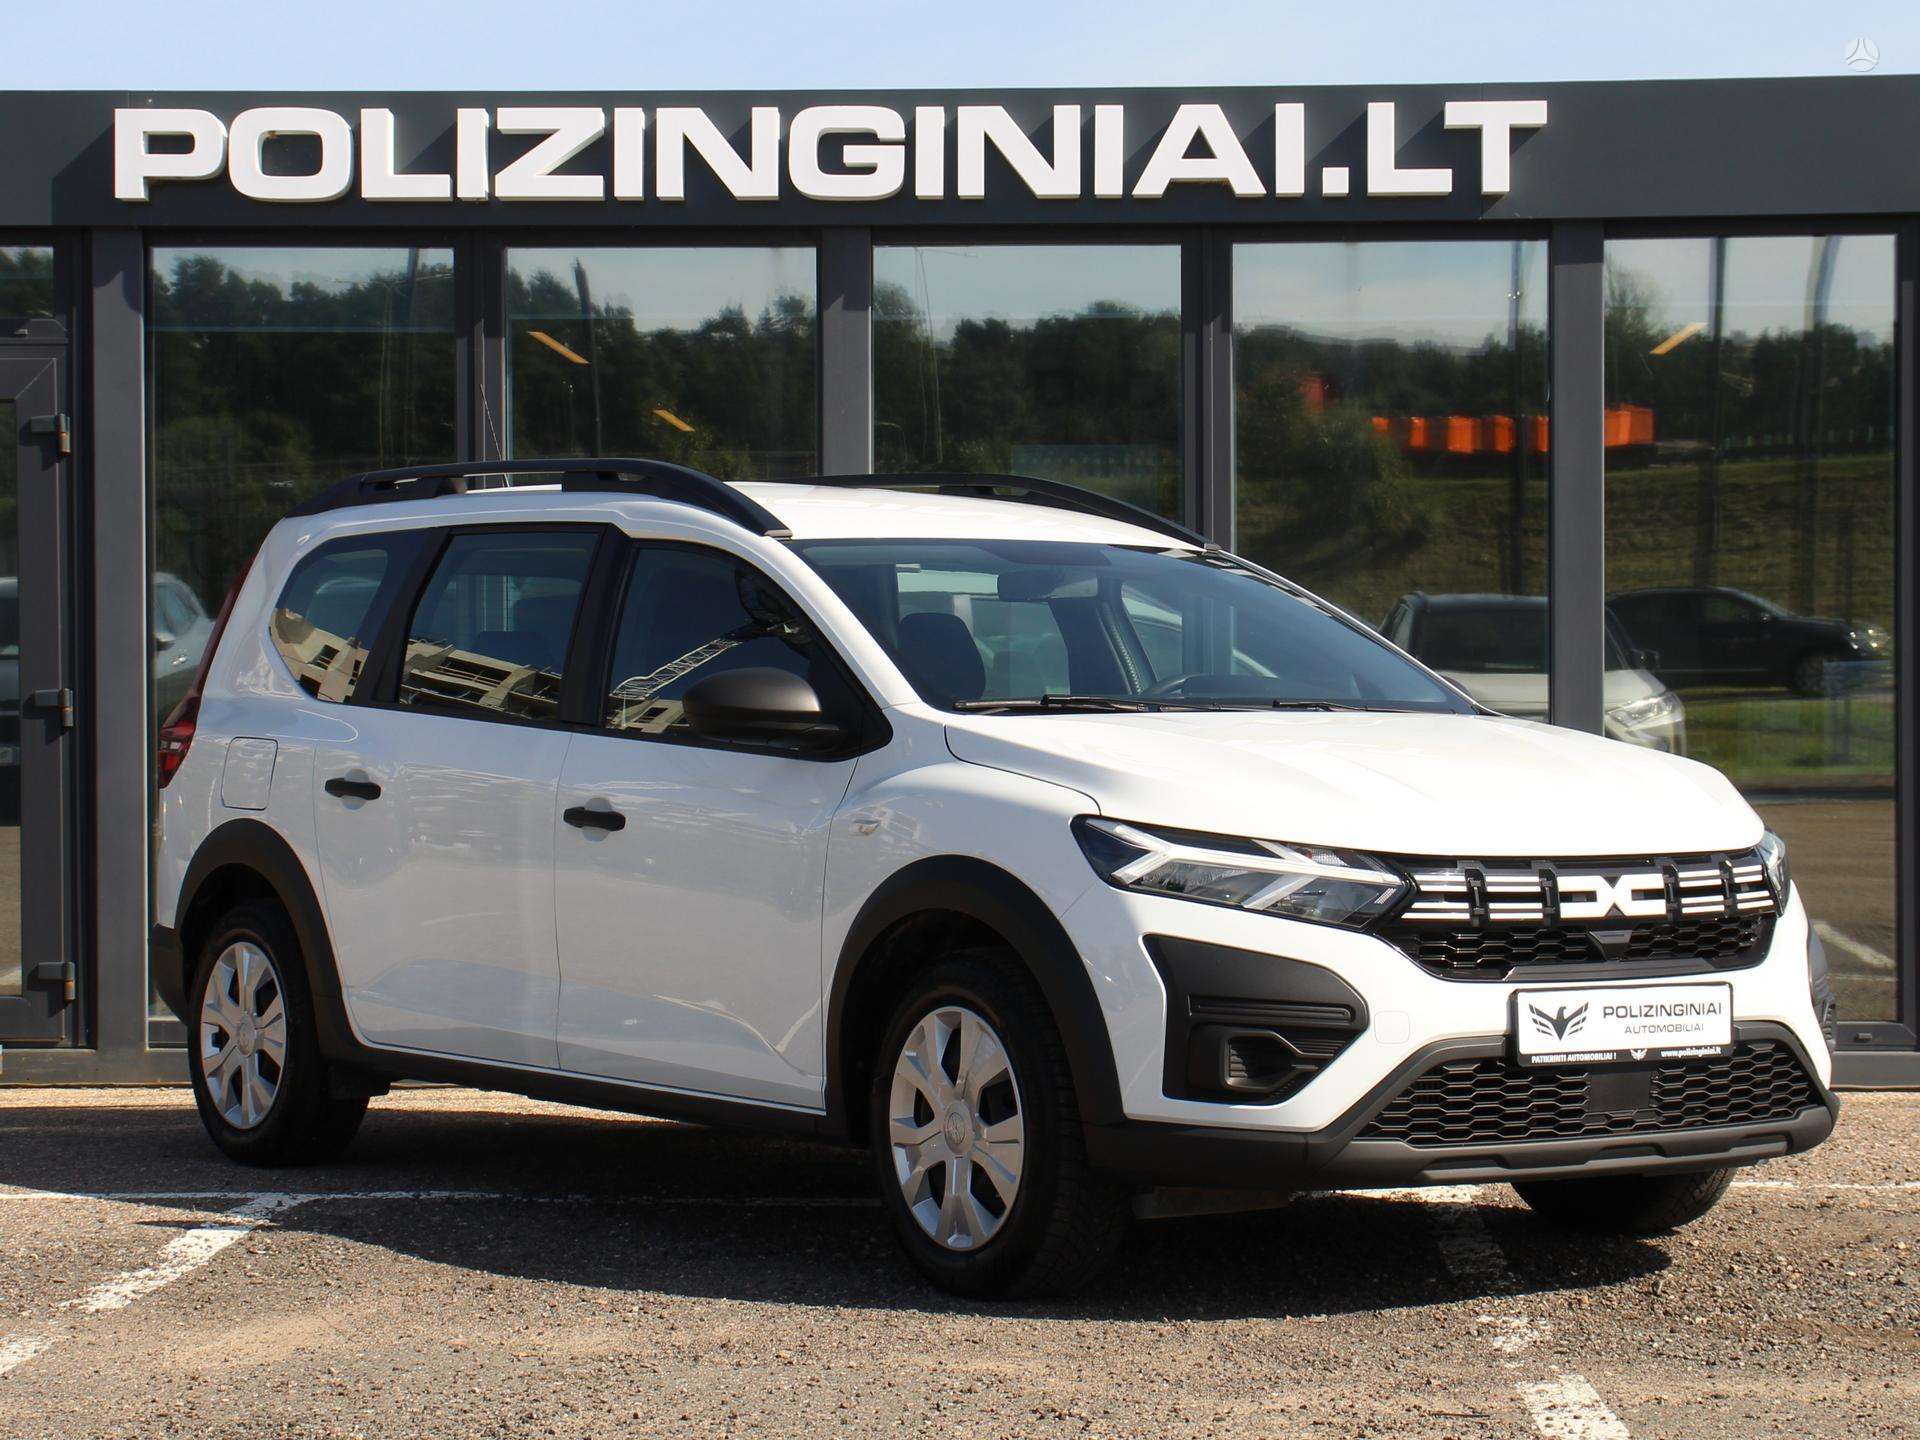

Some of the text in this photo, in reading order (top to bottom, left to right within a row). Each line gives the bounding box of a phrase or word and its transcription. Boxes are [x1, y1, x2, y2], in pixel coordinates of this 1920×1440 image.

[113, 100, 1549, 203] POLIZINGINIAI.LT
[1603, 1002, 1722, 1019] POLIZINGINIAI
[1624, 1023, 1703, 1034] AUTOMOBILIAI
